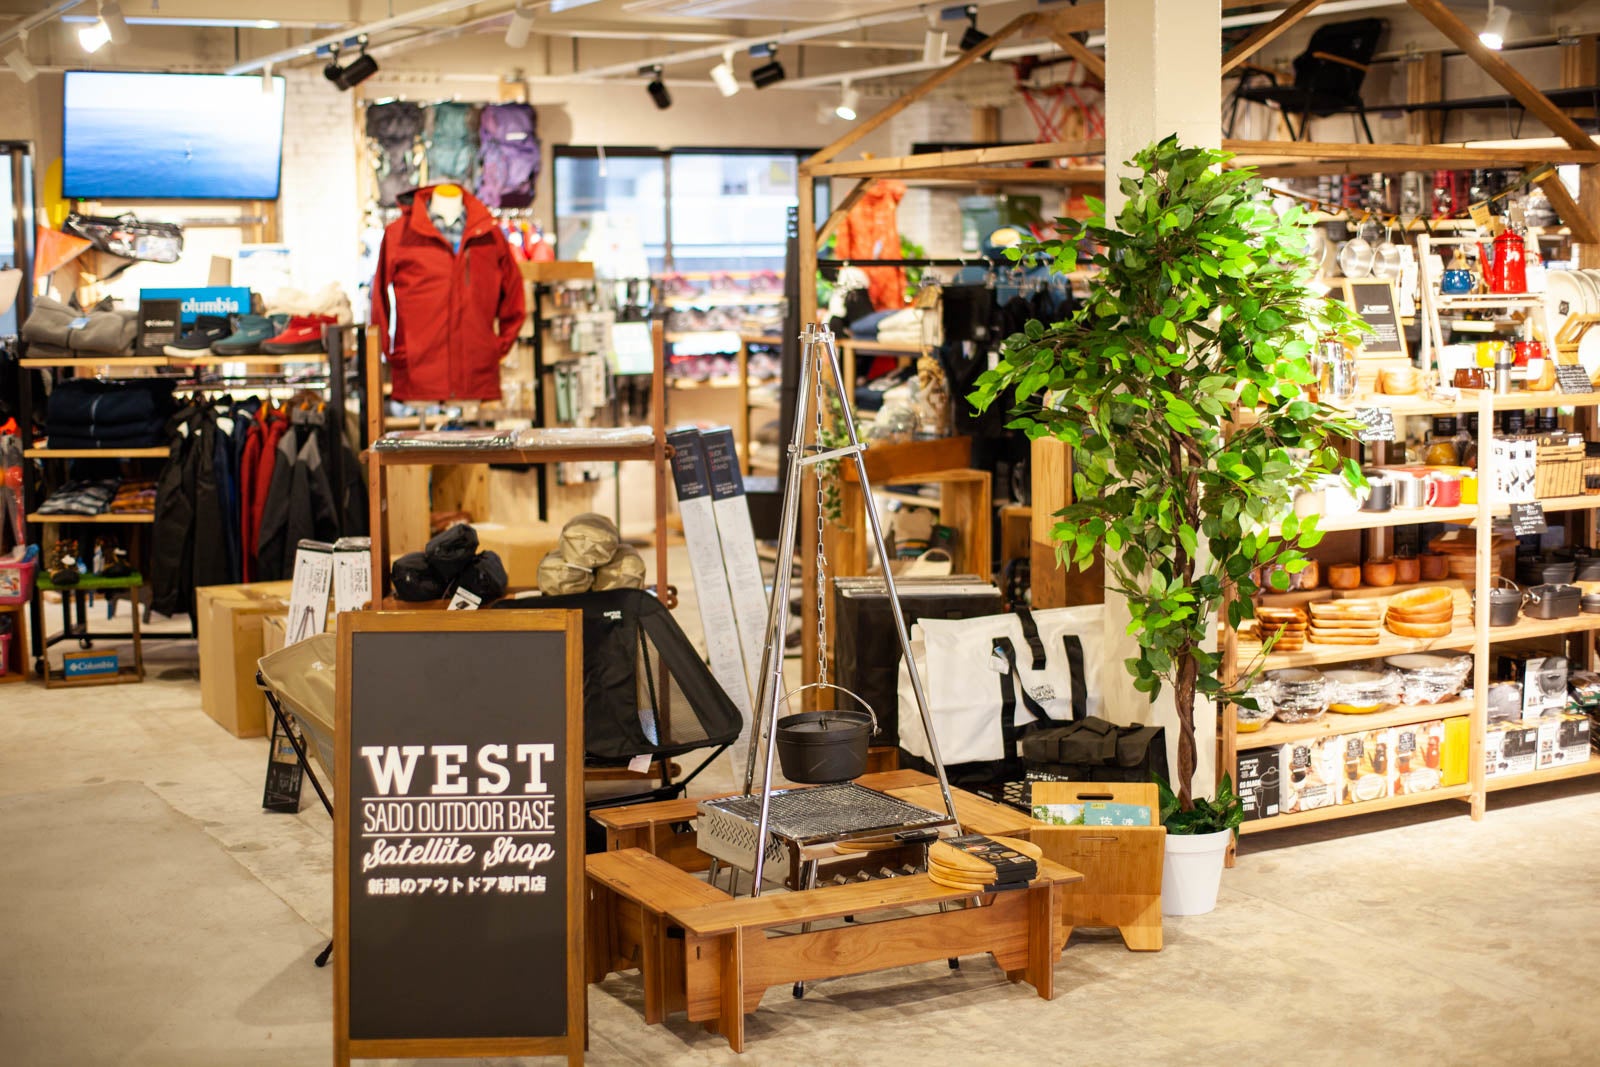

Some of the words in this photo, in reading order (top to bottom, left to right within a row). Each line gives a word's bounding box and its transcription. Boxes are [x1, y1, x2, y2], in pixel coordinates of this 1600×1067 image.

[181, 298, 239, 314] olumbia
[361, 744, 555, 795] WEST
[364, 802, 413, 832] SADO
[418, 801, 504, 831] OUTDOOR
[509, 800, 555, 829] BASE
[363, 837, 475, 873] Satellite
[483, 836, 555, 871] Shop
[367, 875, 547, 896] 新潟のアウトドア専門店
